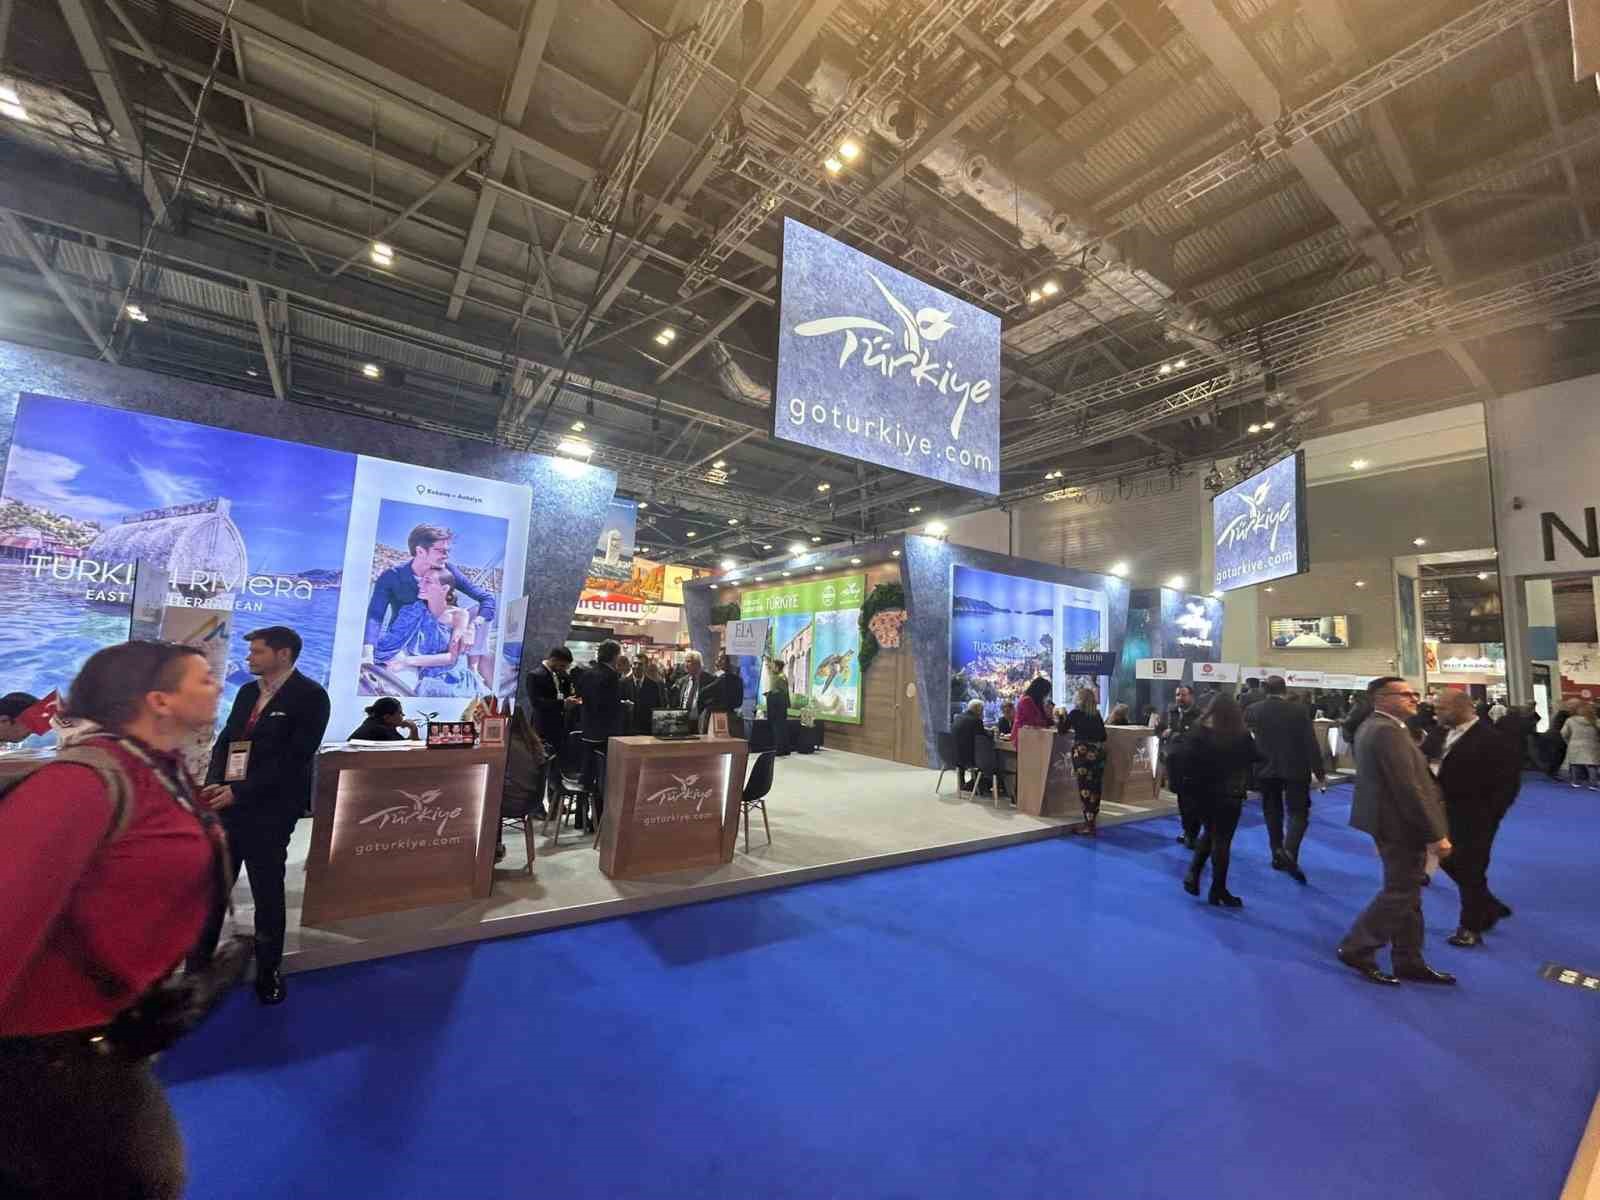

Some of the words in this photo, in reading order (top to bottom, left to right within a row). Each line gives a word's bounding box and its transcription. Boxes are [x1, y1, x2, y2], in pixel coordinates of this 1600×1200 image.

[793, 316, 992, 440] Türkiye
[789, 398, 992, 473] goturkiye.com
[1217, 500, 1291, 552] Türkiye
[1216, 551, 1293, 585] goturkiye.com
[359, 804, 466, 836] Türkiye
[355, 835, 463, 856] goturkiye.com
